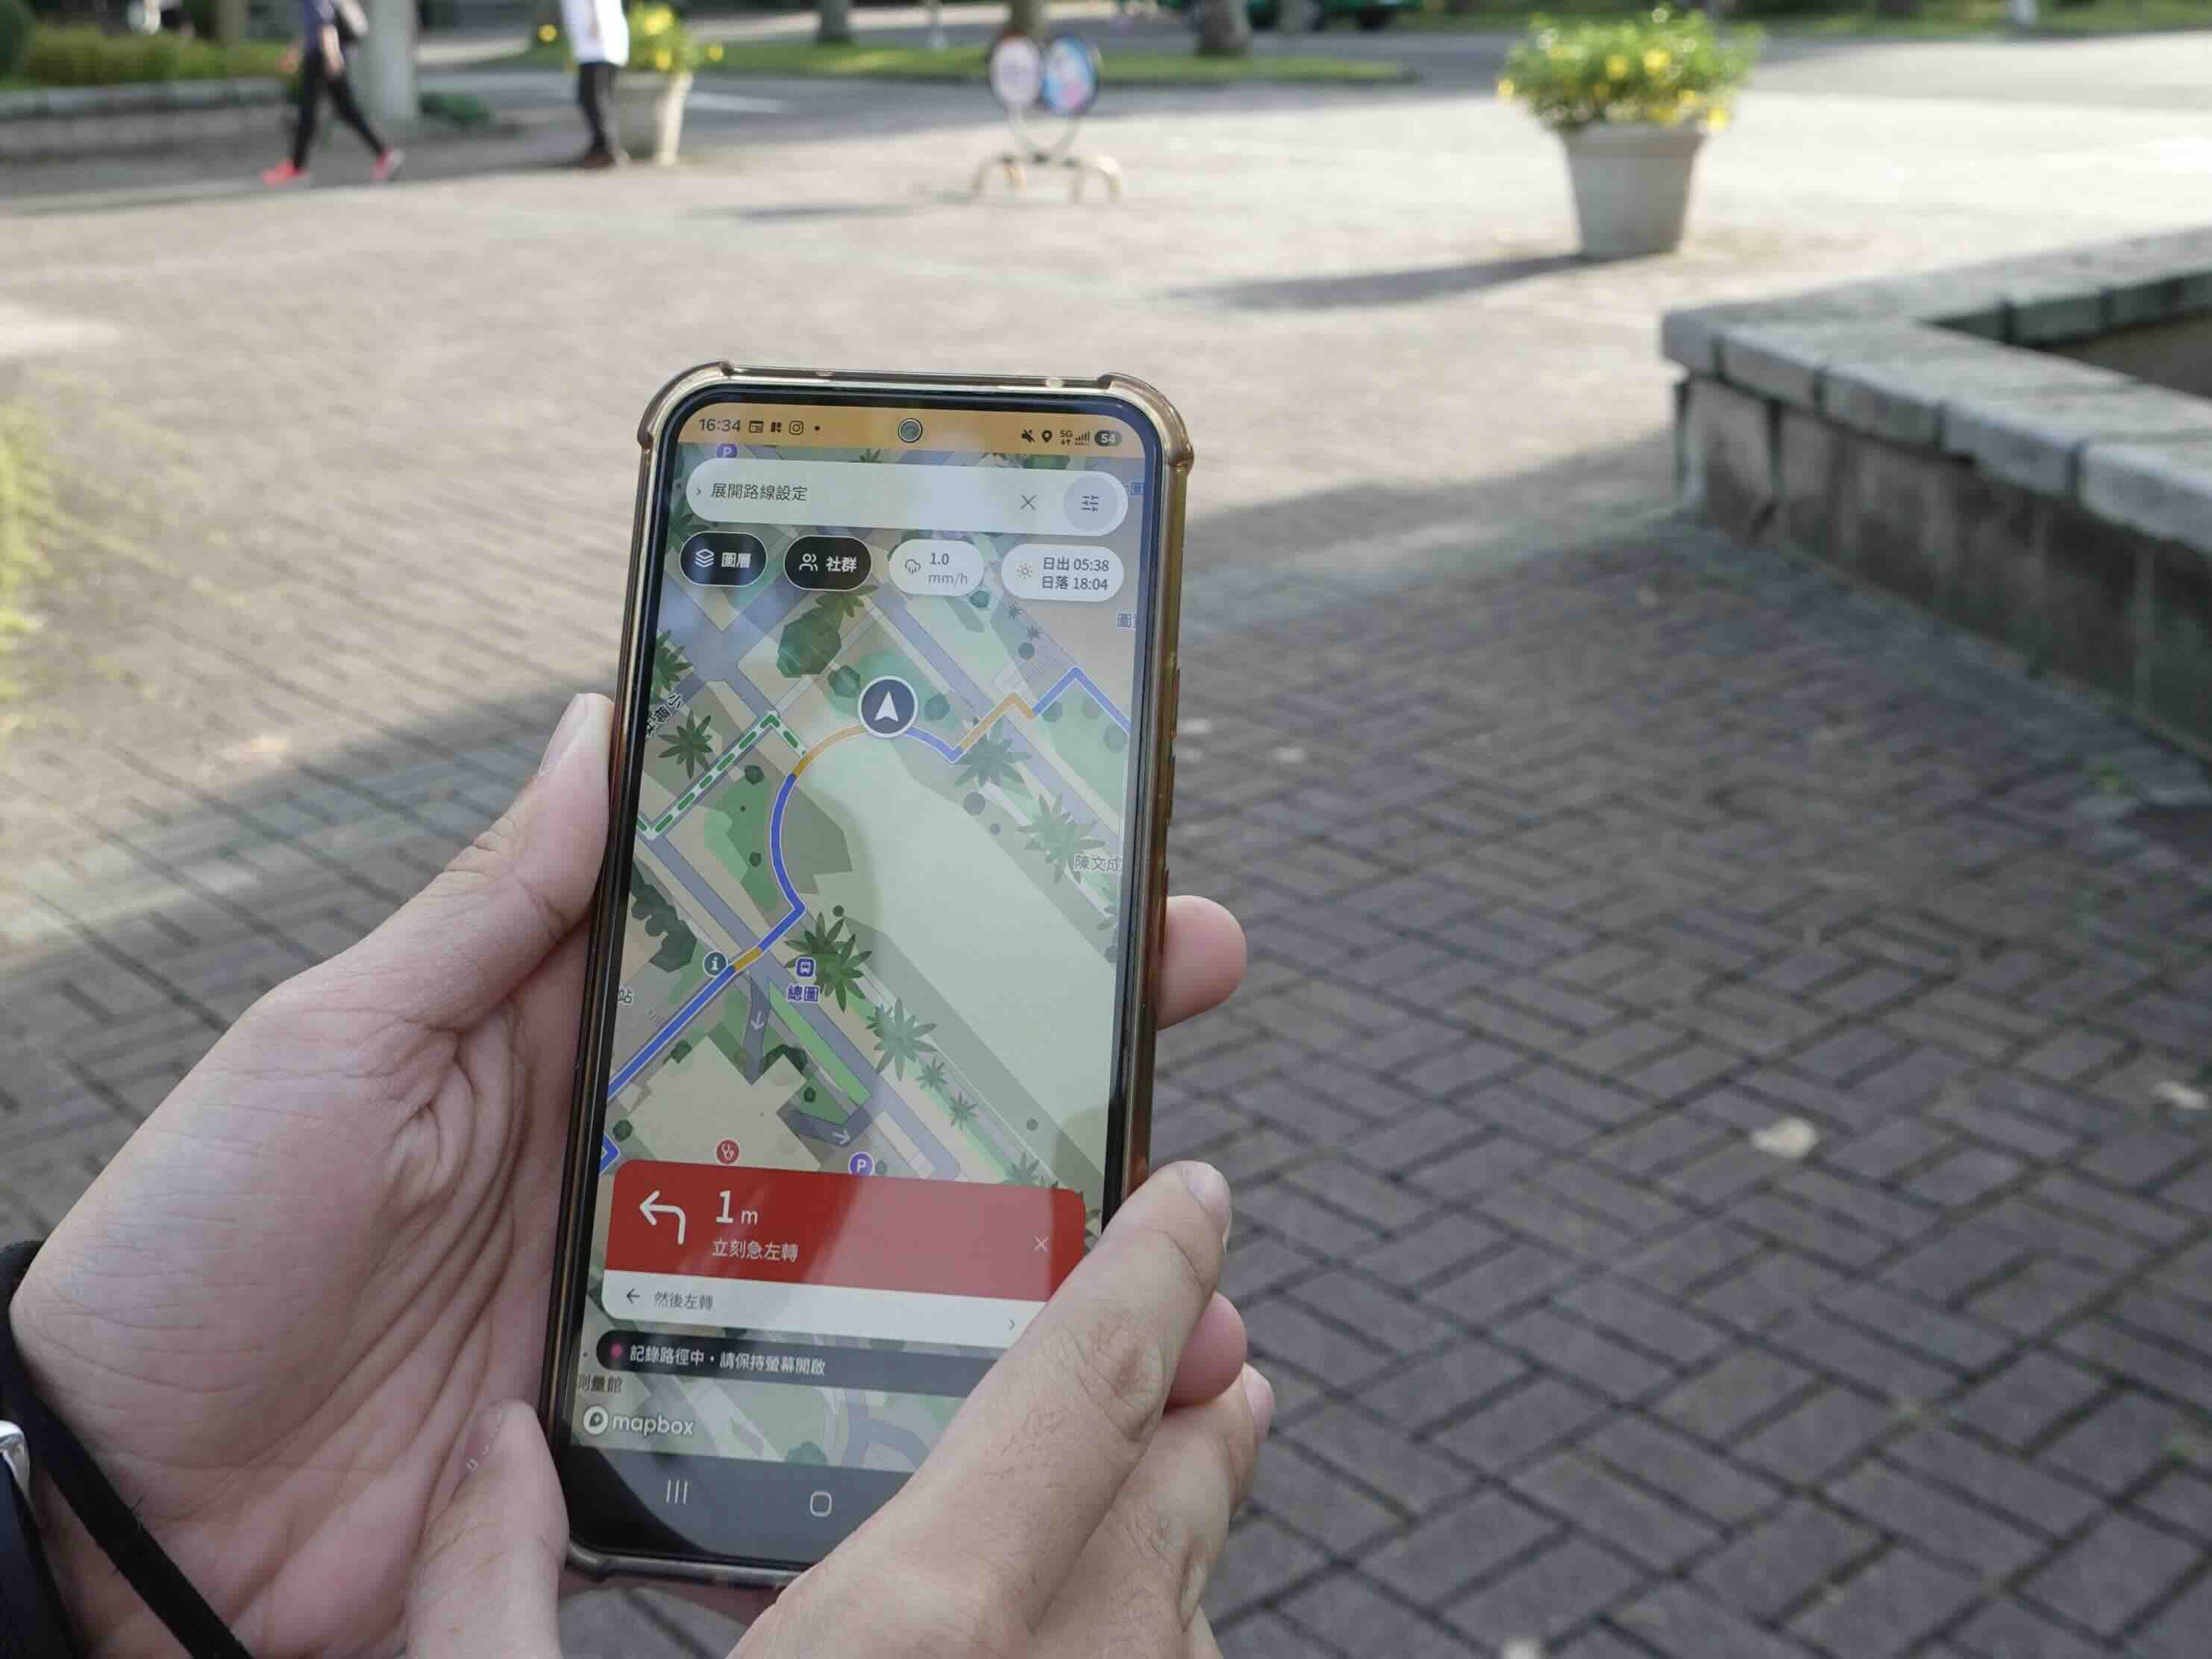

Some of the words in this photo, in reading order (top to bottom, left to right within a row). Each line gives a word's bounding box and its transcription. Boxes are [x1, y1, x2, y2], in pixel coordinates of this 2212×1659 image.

[699, 419, 741, 432] 16:34
[1060, 430, 1074, 438] 5G
[711, 483, 807, 502] 展開路線設定
[721, 551, 752, 569] 圖層
[825, 556, 858, 573] 社群
[930, 553, 950, 565] 1.0
[1043, 557, 1069, 571] 日出
[1073, 558, 1109, 572] 05:38
[927, 571, 968, 586] mm/h
[1041, 577, 1068, 591] 日落
[1073, 578, 1109, 591] 18:04
[715, 1190, 734, 1224] 1
[740, 1208, 758, 1224] m
[711, 1236, 800, 1263] 立刻急左轉
[612, 1413, 695, 1437] mapbox
